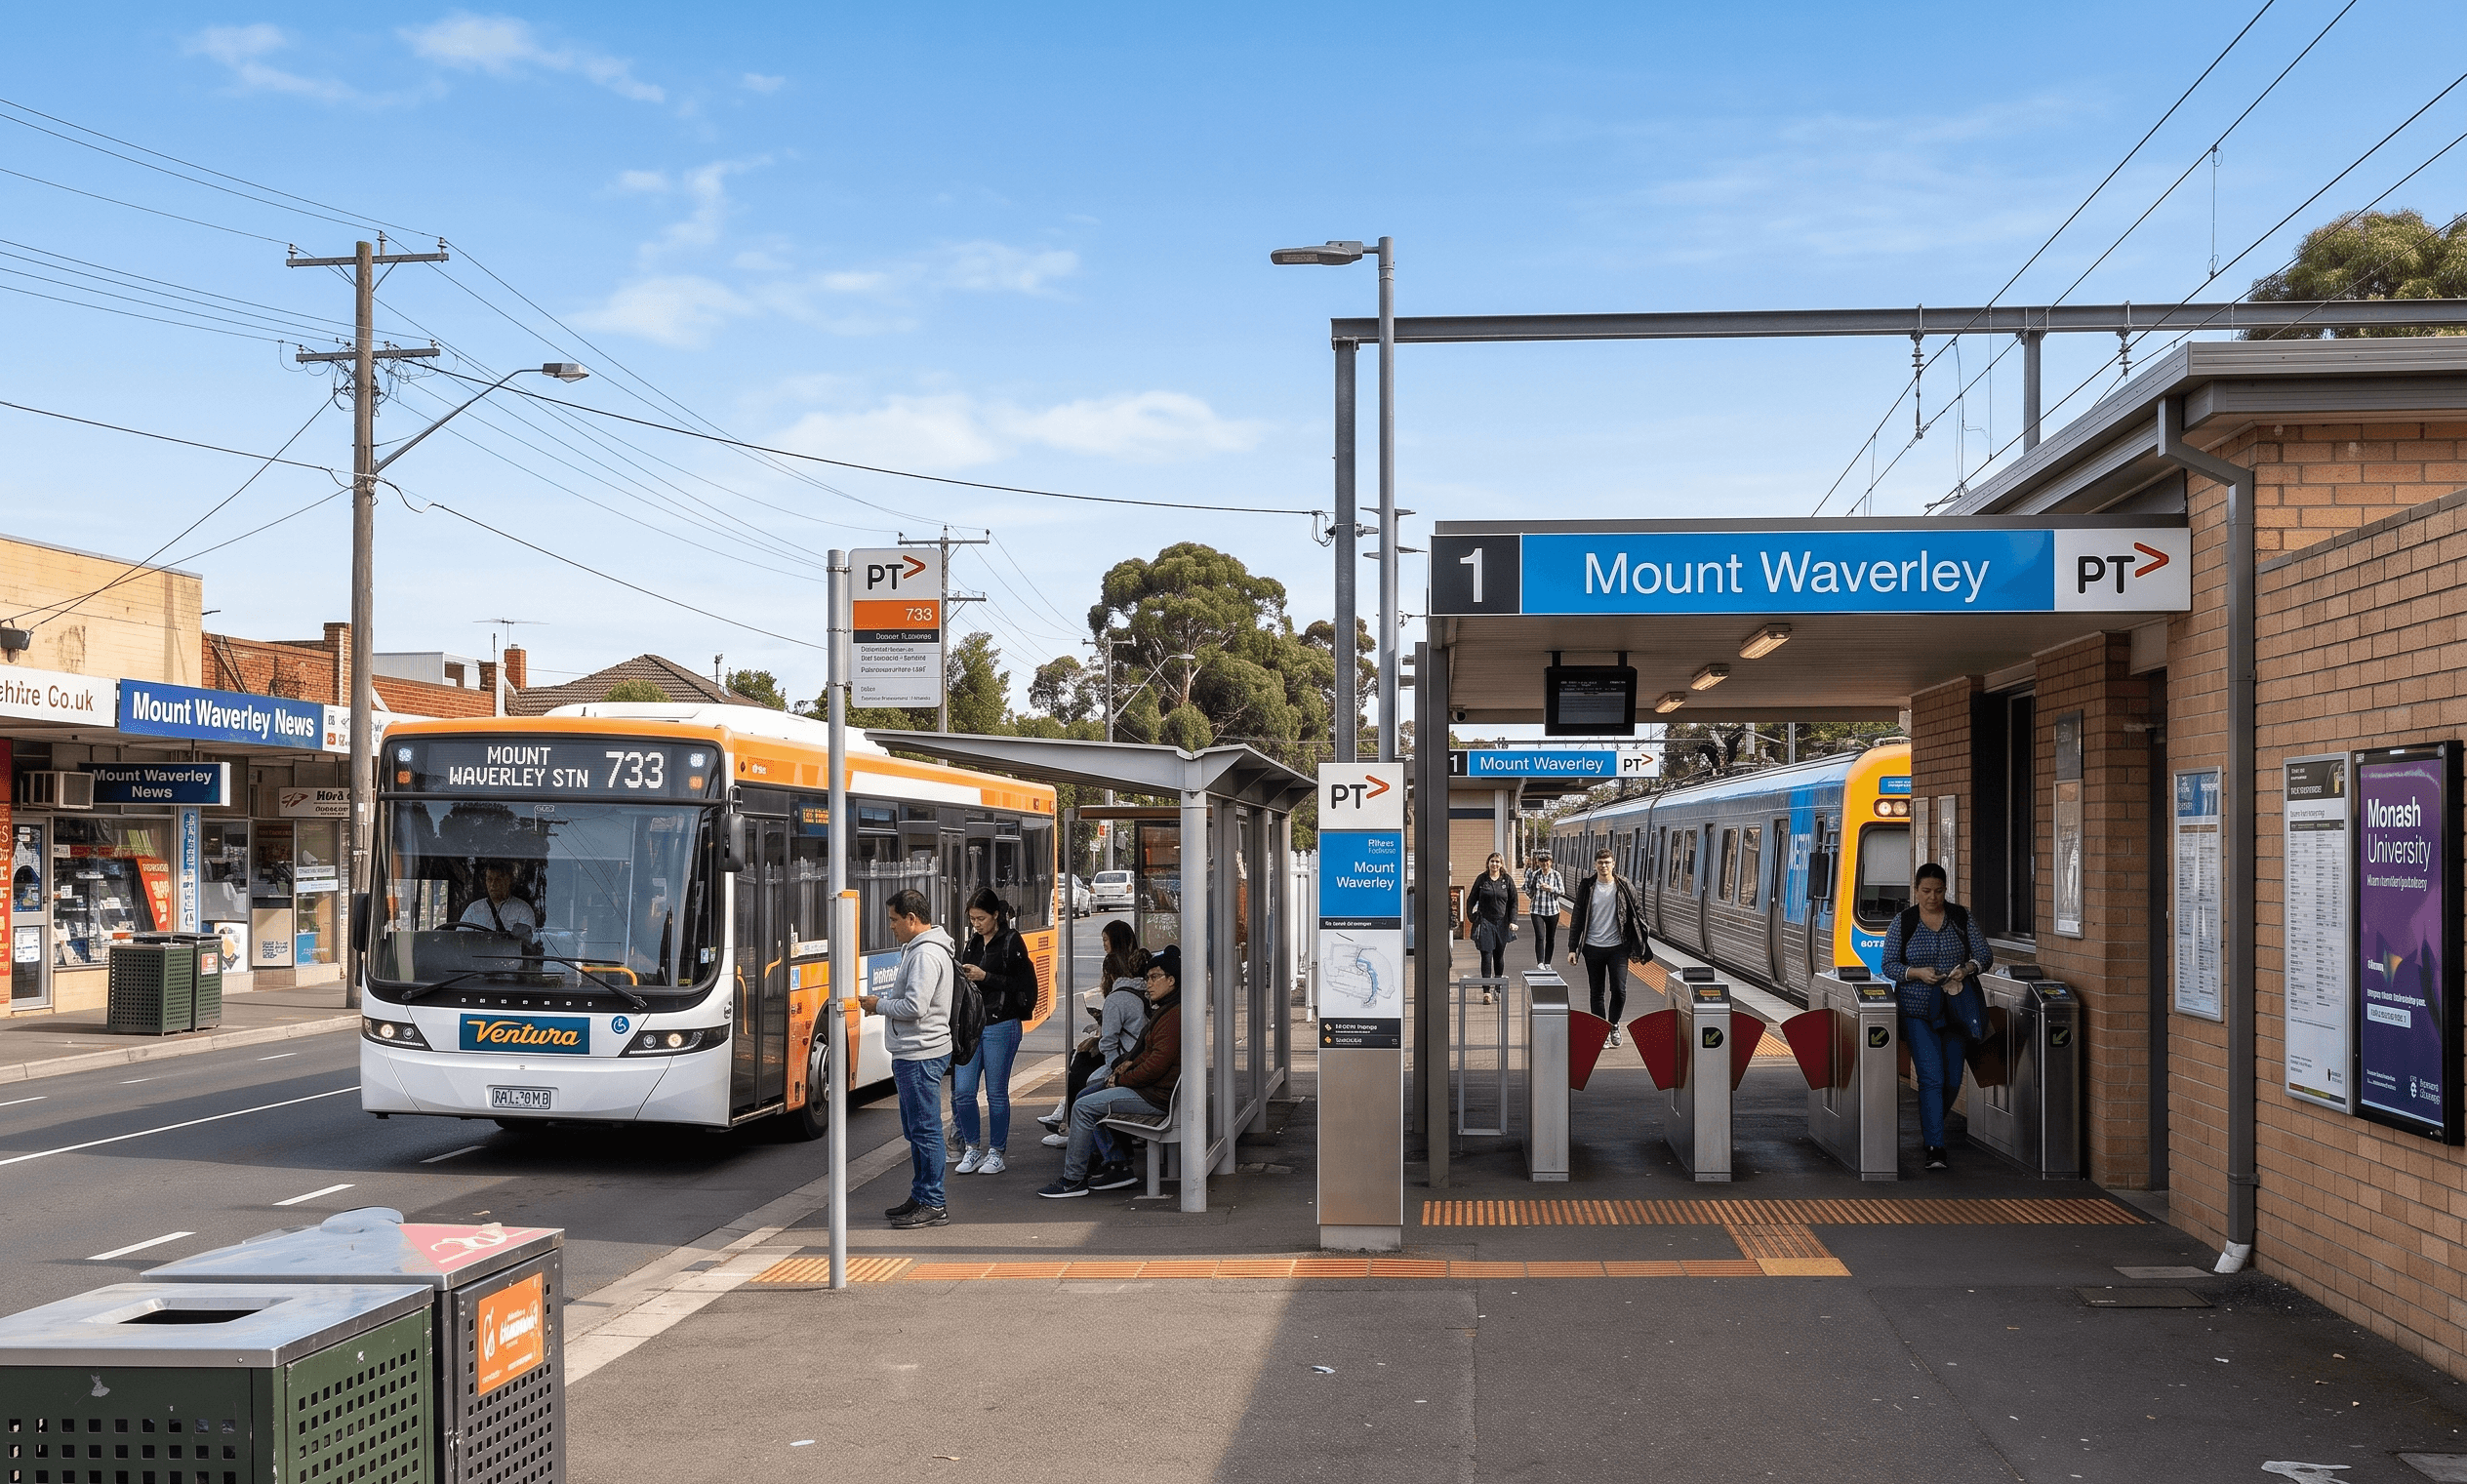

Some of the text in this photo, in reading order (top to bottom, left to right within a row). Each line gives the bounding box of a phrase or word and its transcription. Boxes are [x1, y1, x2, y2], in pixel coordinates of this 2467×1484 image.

[1459, 547, 1482, 603] 1
[1585, 552, 1743, 594] Mount
[1759, 549, 1990, 603] Waverley
[905, 608, 933, 622] 733
[48, 684, 94, 712] Co.uk
[133, 691, 192, 725] Mount
[195, 698, 271, 740] Waverley
[274, 707, 314, 738] News
[487, 745, 551, 766] MOUNT
[1449, 754, 1458, 773] 1
[1479, 756, 1529, 771] Mount
[1533, 756, 1604, 774] Waverley
[93, 769, 213, 785] Mount Waverley
[449, 766, 588, 788] WAVERLEY STN
[605, 750, 665, 789] 733
[132, 785, 173, 798] News
[2367, 795, 2421, 828] Monash
[2367, 833, 2431, 872] University
[1354, 861, 1395, 873] Mount
[1336, 876, 1395, 891] Waverley
[466, 1020, 582, 1046] Ventura
